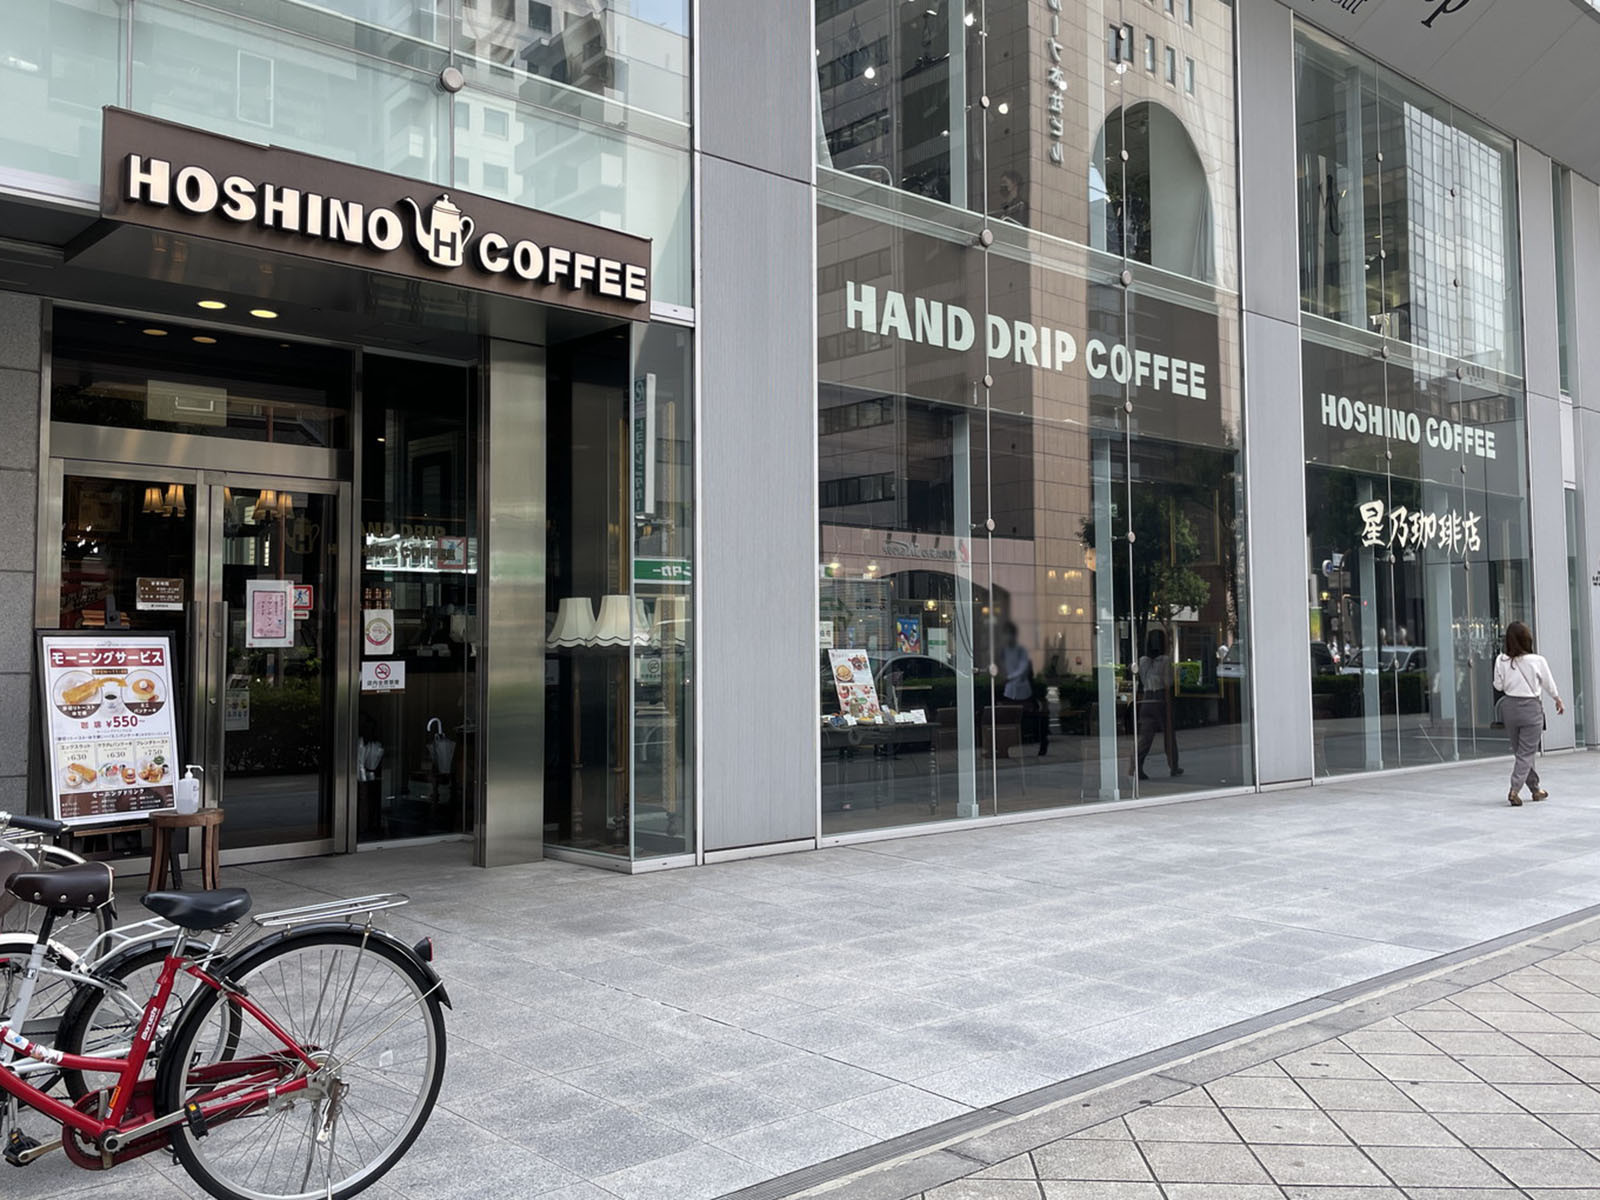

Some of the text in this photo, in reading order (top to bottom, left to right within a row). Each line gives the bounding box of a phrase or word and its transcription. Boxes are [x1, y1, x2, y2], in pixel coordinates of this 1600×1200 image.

[128, 154, 403, 251] HOSHINO
[478, 232, 647, 302] COFFEE
[846, 280, 1207, 400] HAND DRIP COFFEE
[1321, 393, 1496, 460] HOSHINO COFFEE
[1359, 499, 1482, 557] 星乃珈琲店
[52, 651, 163, 665] モーニングサービス
[106, 715, 138, 728] ¥550
